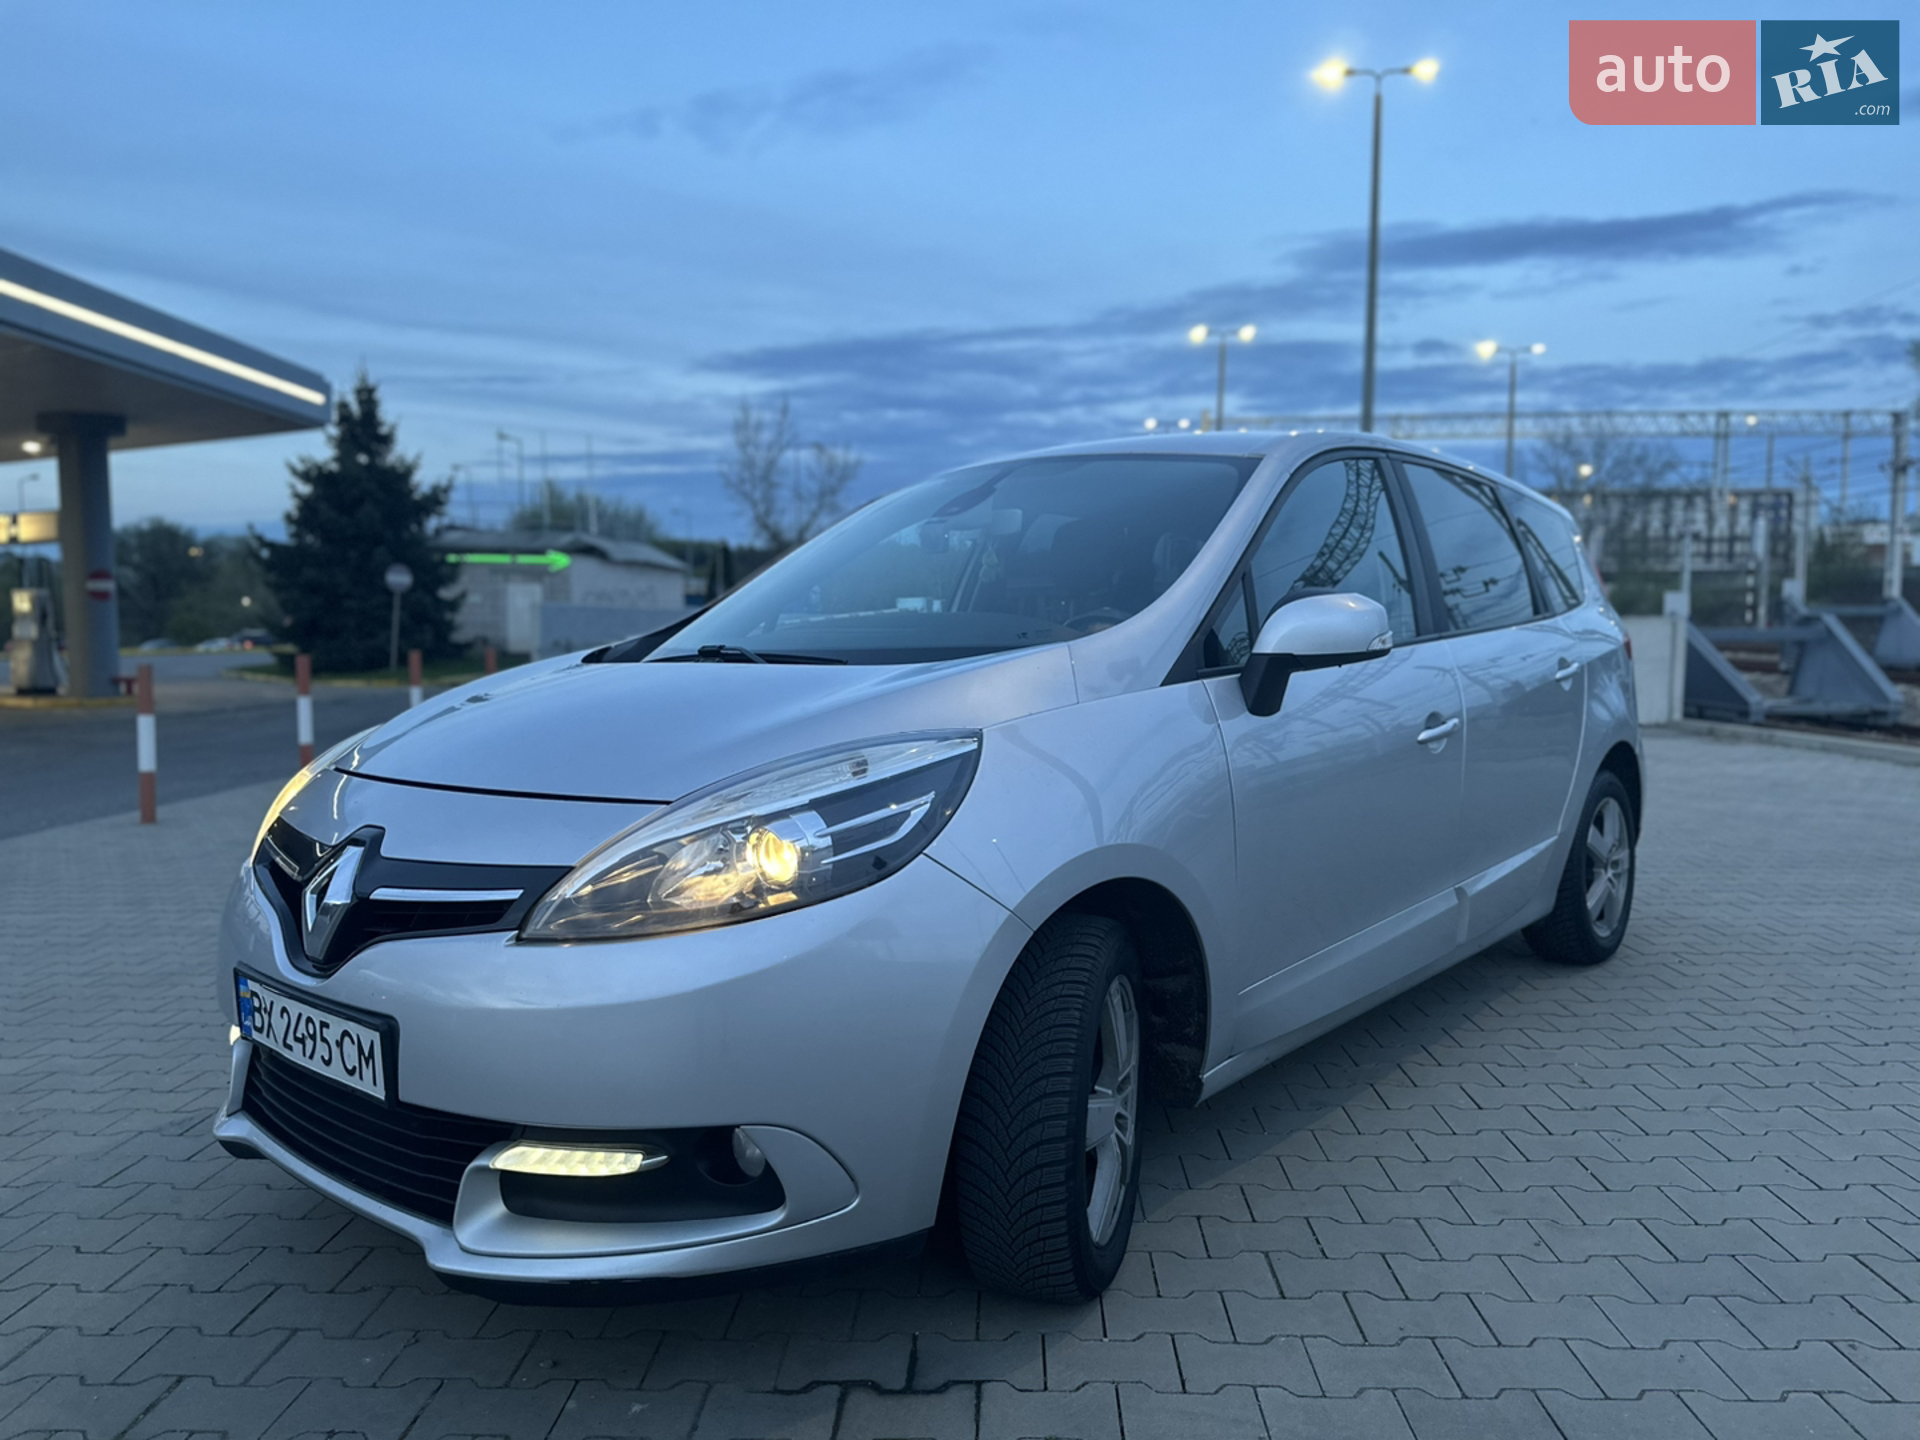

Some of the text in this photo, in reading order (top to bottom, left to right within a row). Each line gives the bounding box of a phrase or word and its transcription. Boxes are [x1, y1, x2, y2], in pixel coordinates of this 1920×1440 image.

[250, 989, 377, 1087] BX 2495 CM
